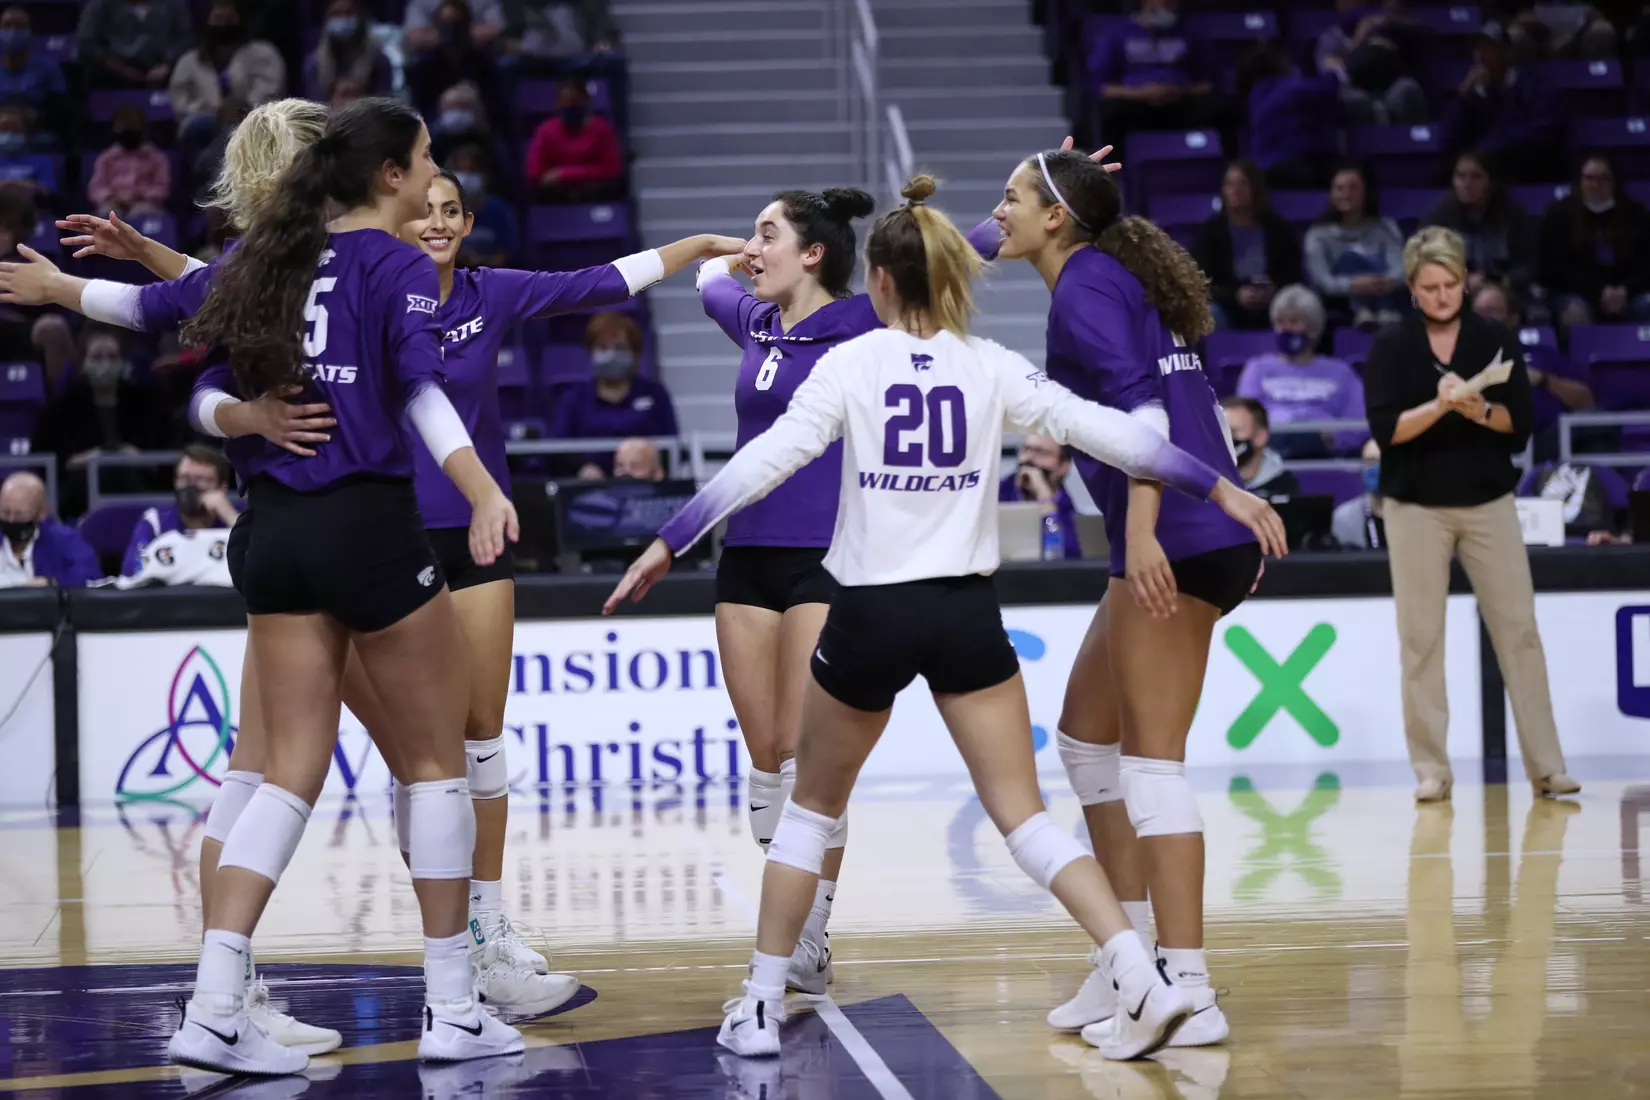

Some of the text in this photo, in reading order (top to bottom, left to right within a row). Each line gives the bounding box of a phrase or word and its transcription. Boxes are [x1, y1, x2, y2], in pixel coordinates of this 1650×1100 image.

[302, 277, 338, 358] 5
[302, 363, 358, 384] ATS
[755, 346, 783, 391] 6
[883, 384, 967, 468] 20
[859, 470, 981, 492] WILDCATS
